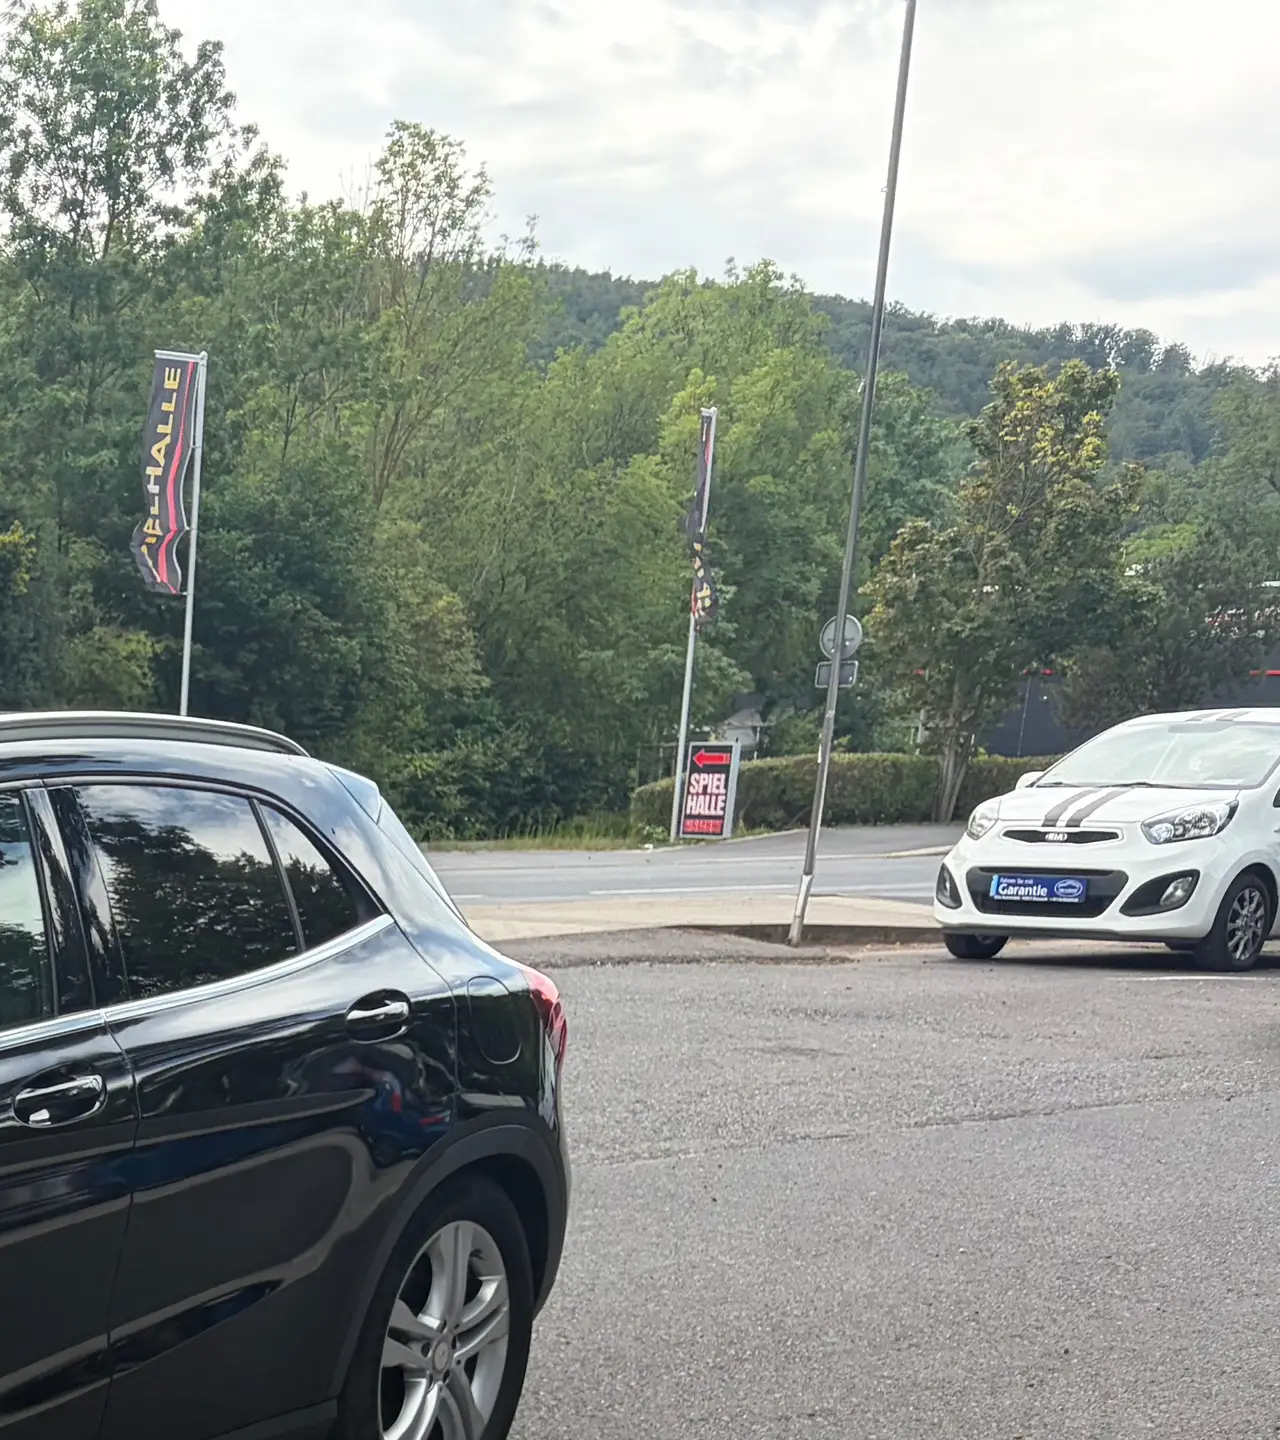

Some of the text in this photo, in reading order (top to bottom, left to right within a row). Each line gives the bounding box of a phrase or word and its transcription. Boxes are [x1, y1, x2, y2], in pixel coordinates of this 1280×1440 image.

[689, 772, 726, 794] SPIEL
[686, 794, 726, 816] HALLE
[998, 883, 1048, 896] Garantie
